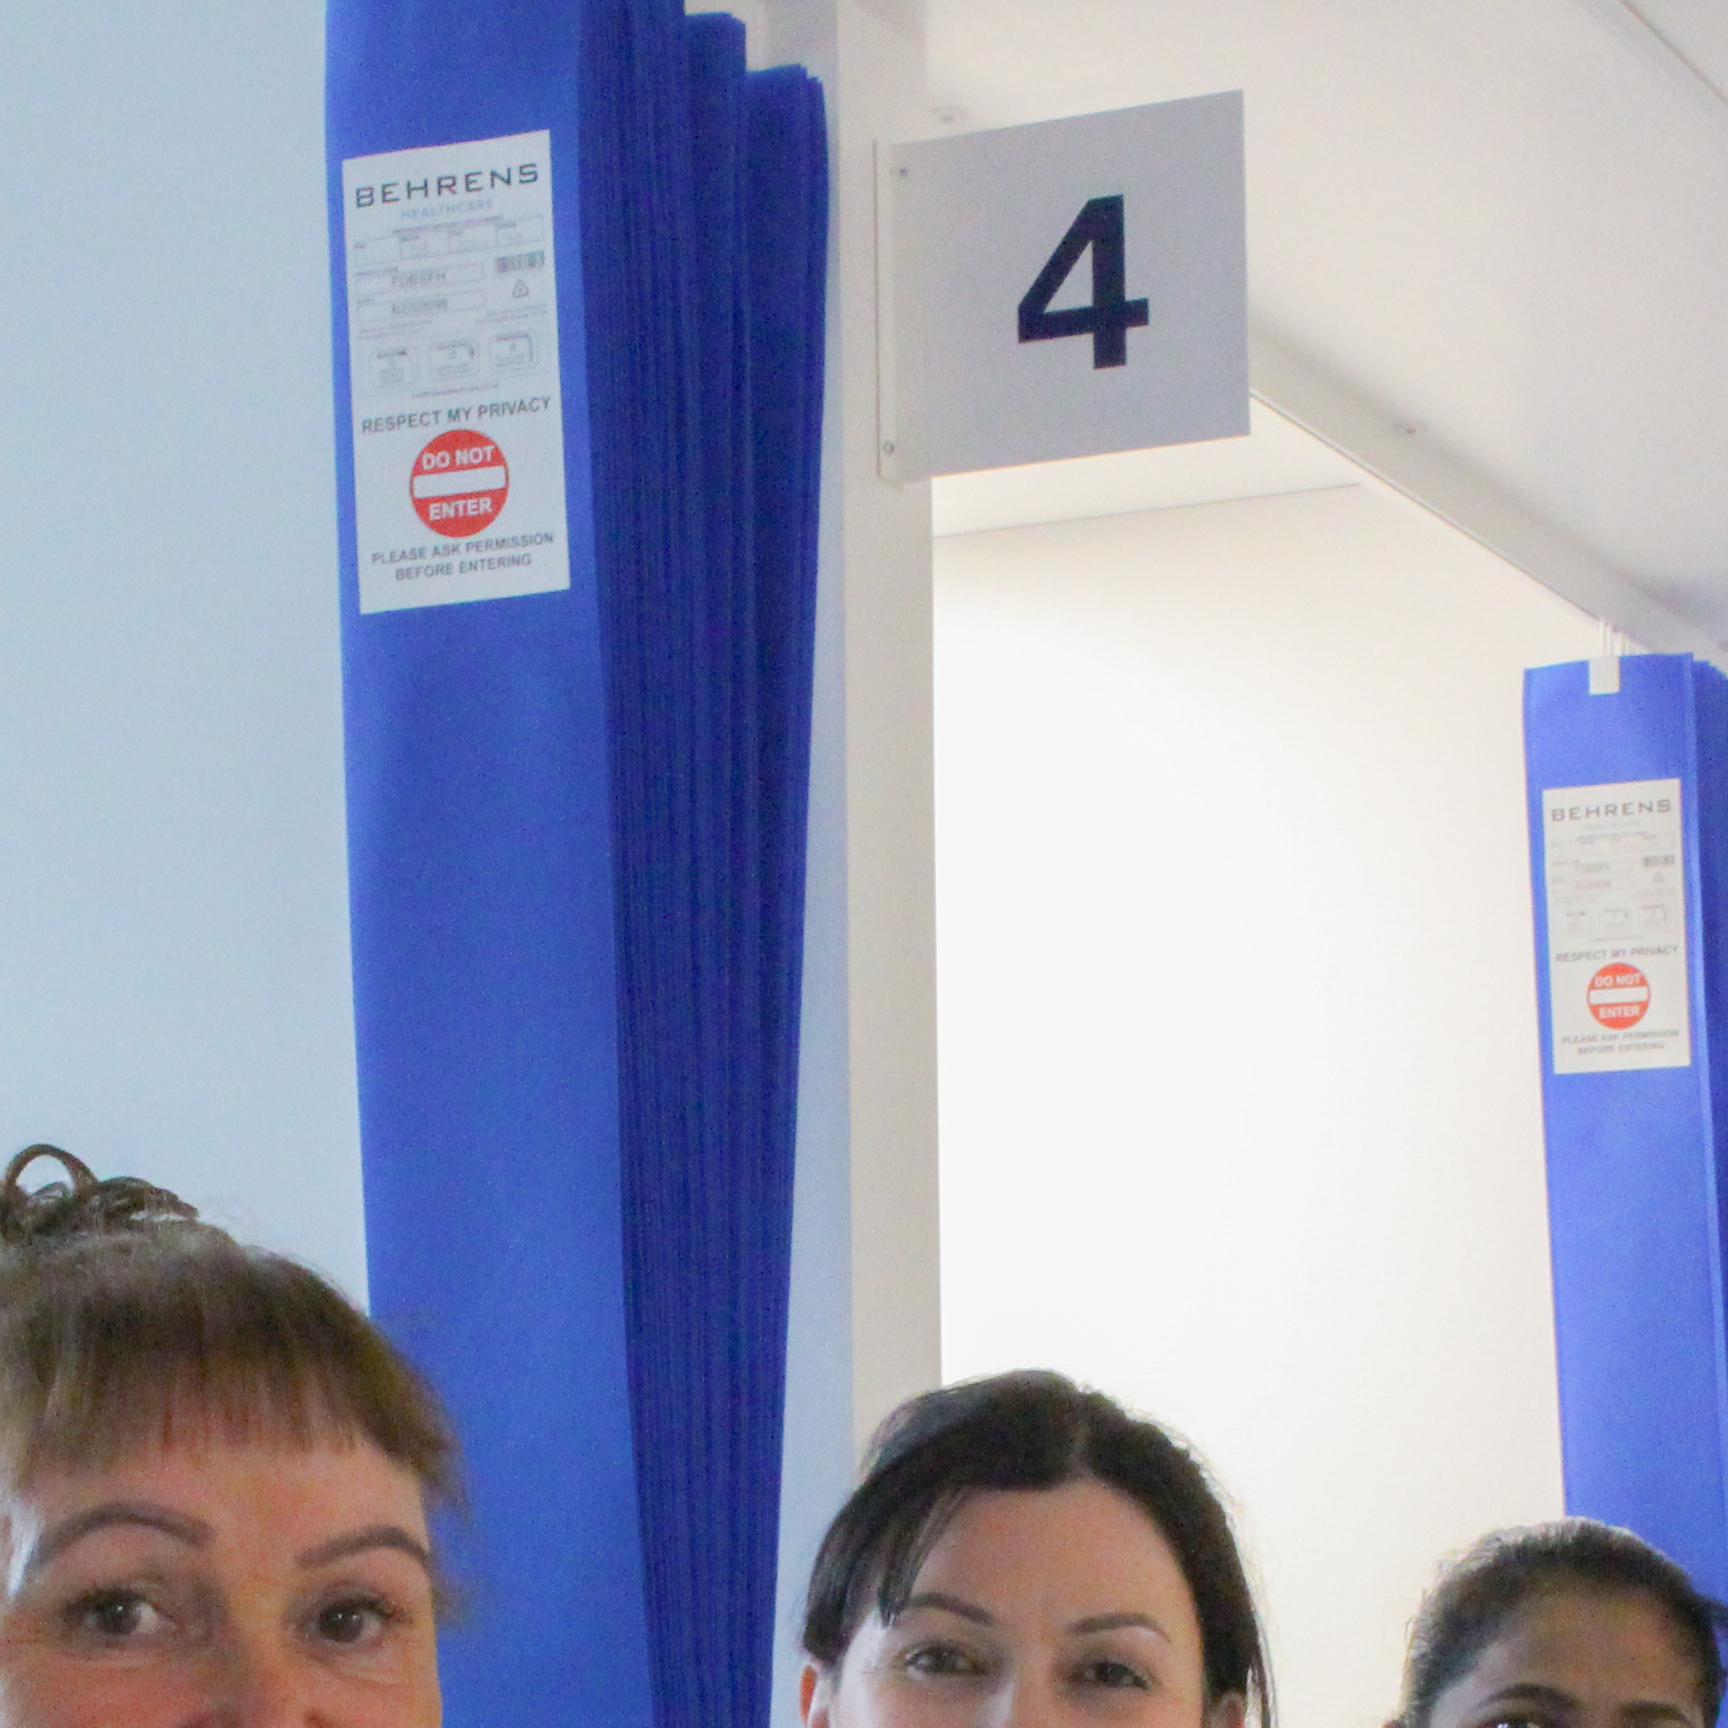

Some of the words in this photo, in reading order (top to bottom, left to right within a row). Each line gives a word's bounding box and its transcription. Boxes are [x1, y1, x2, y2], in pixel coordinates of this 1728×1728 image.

[355, 163, 539, 209] BEHRENS
[1018, 194, 1150, 370] 4
[362, 410, 443, 434] RESPECT
[447, 406, 473, 424] MY
[478, 396, 552, 420] PRIVACY
[421, 452, 451, 471] DO
[455, 445, 496, 466] NOT
[429, 497, 494, 522] ENTER
[372, 546, 427, 565] PLEASE
[431, 543, 462, 559] ASK
[465, 532, 554, 553] PERMISSION
[395, 561, 454, 582] BEFORE
[459, 553, 532, 575] ENTERING
[1551, 799, 1672, 822] BEHRENS
[1555, 949, 1607, 963] RESPECT
[1594, 975, 1614, 987] DO
[1616, 973, 1642, 986] NOT
[1598, 1005, 1641, 1020] ENTER
